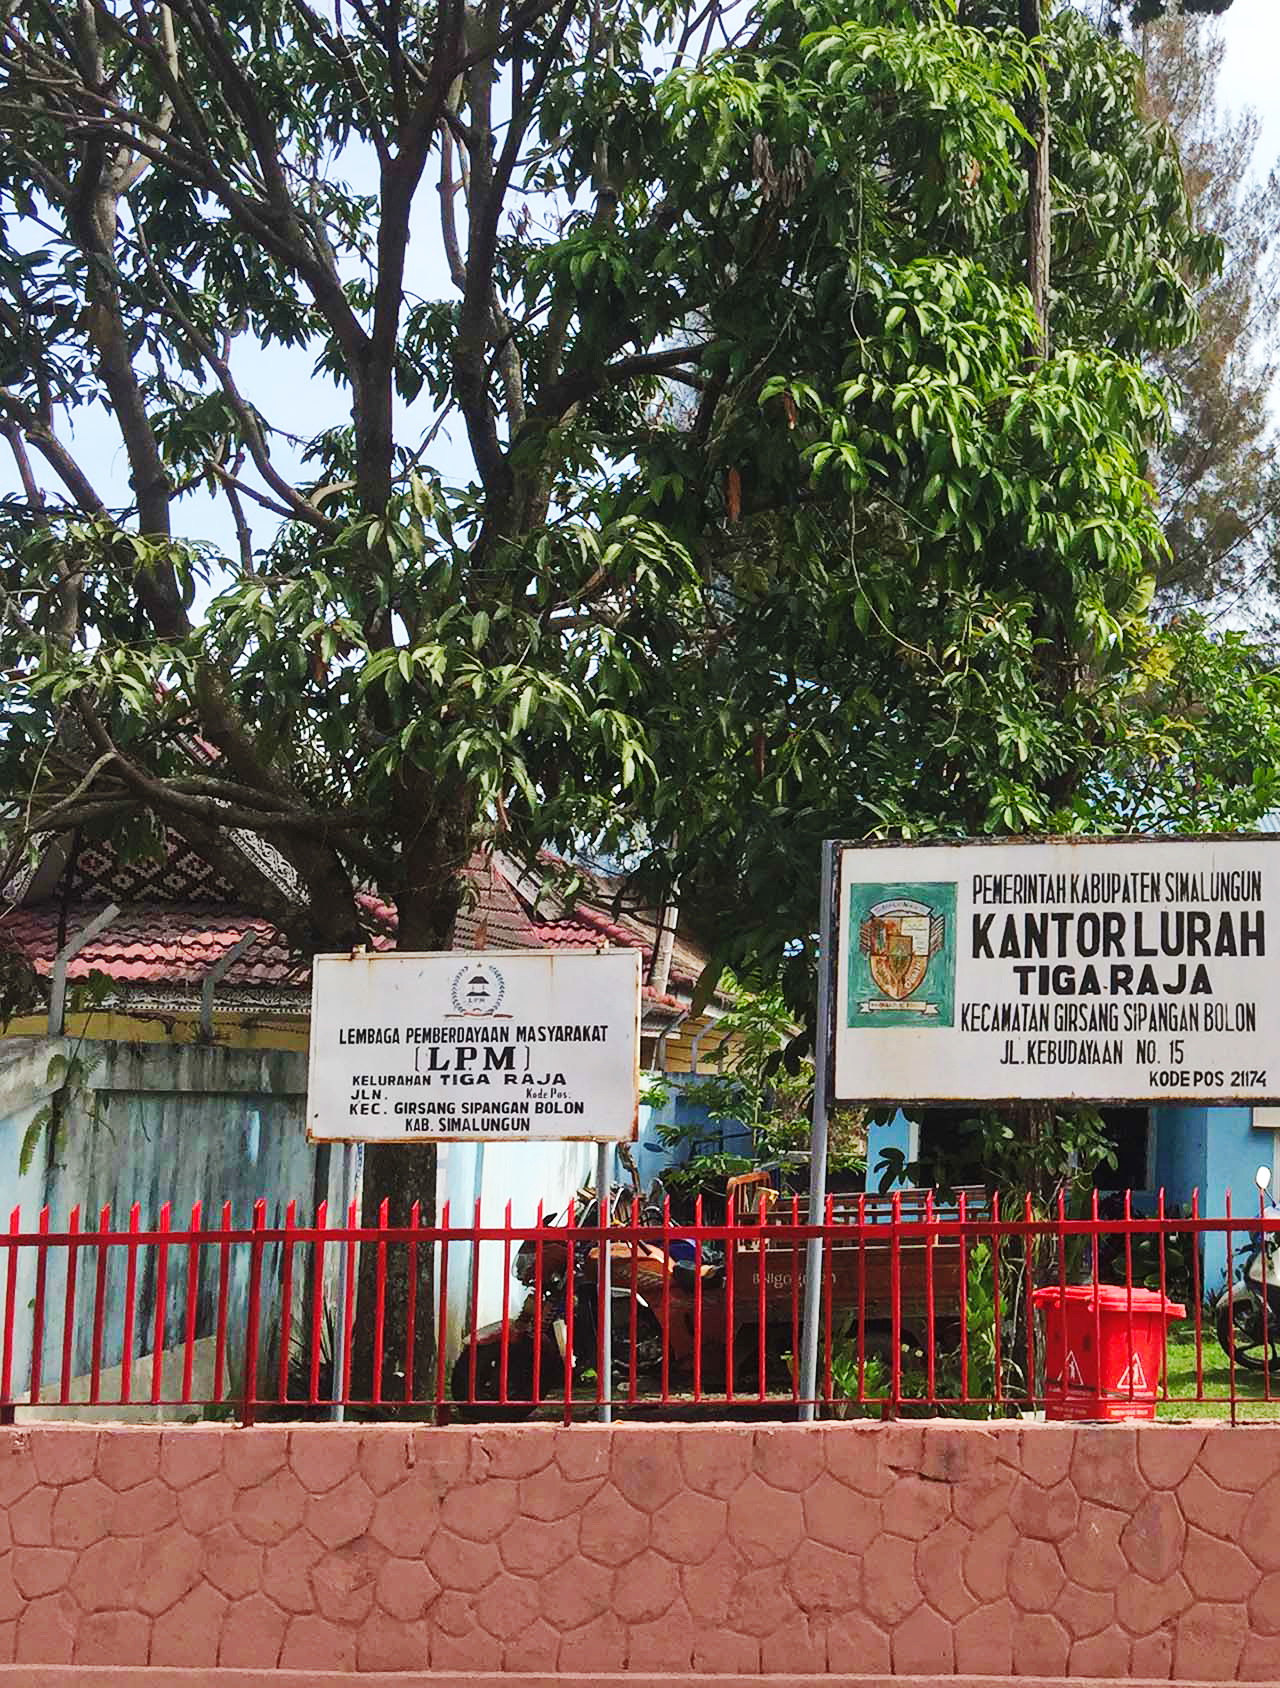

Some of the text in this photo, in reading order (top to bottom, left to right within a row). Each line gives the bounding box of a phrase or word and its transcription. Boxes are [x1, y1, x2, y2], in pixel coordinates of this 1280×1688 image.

[973, 870, 1262, 904] PEMERINTAH KABUPATEN SIMALUNGUN
[972, 910, 1266, 959] KANTOR LURAH
[1013, 963, 1213, 995] TIGA RAJA
[961, 1002, 1256, 1032] KECAMATAN GIRSANG SIPANGAN BOLON
[339, 1025, 608, 1045] LEMBAGA PEMBERDAYAAN MASYARAKAT
[1000, 1039, 1185, 1065] JL. KEBUDAYAAN NO. 15
[352, 1073, 567, 1087] KELURAHAN TIGA RAJA
[1149, 1069, 1268, 1088] KODE POS 21174
[350, 1089, 388, 1101] JLN.
[526, 1088, 548, 1099] Kode
[349, 1101, 585, 1116] KEC. GIRSANG SIPANGAN BOLON
[405, 1117, 531, 1132] KAB. SIMALUNGUN
